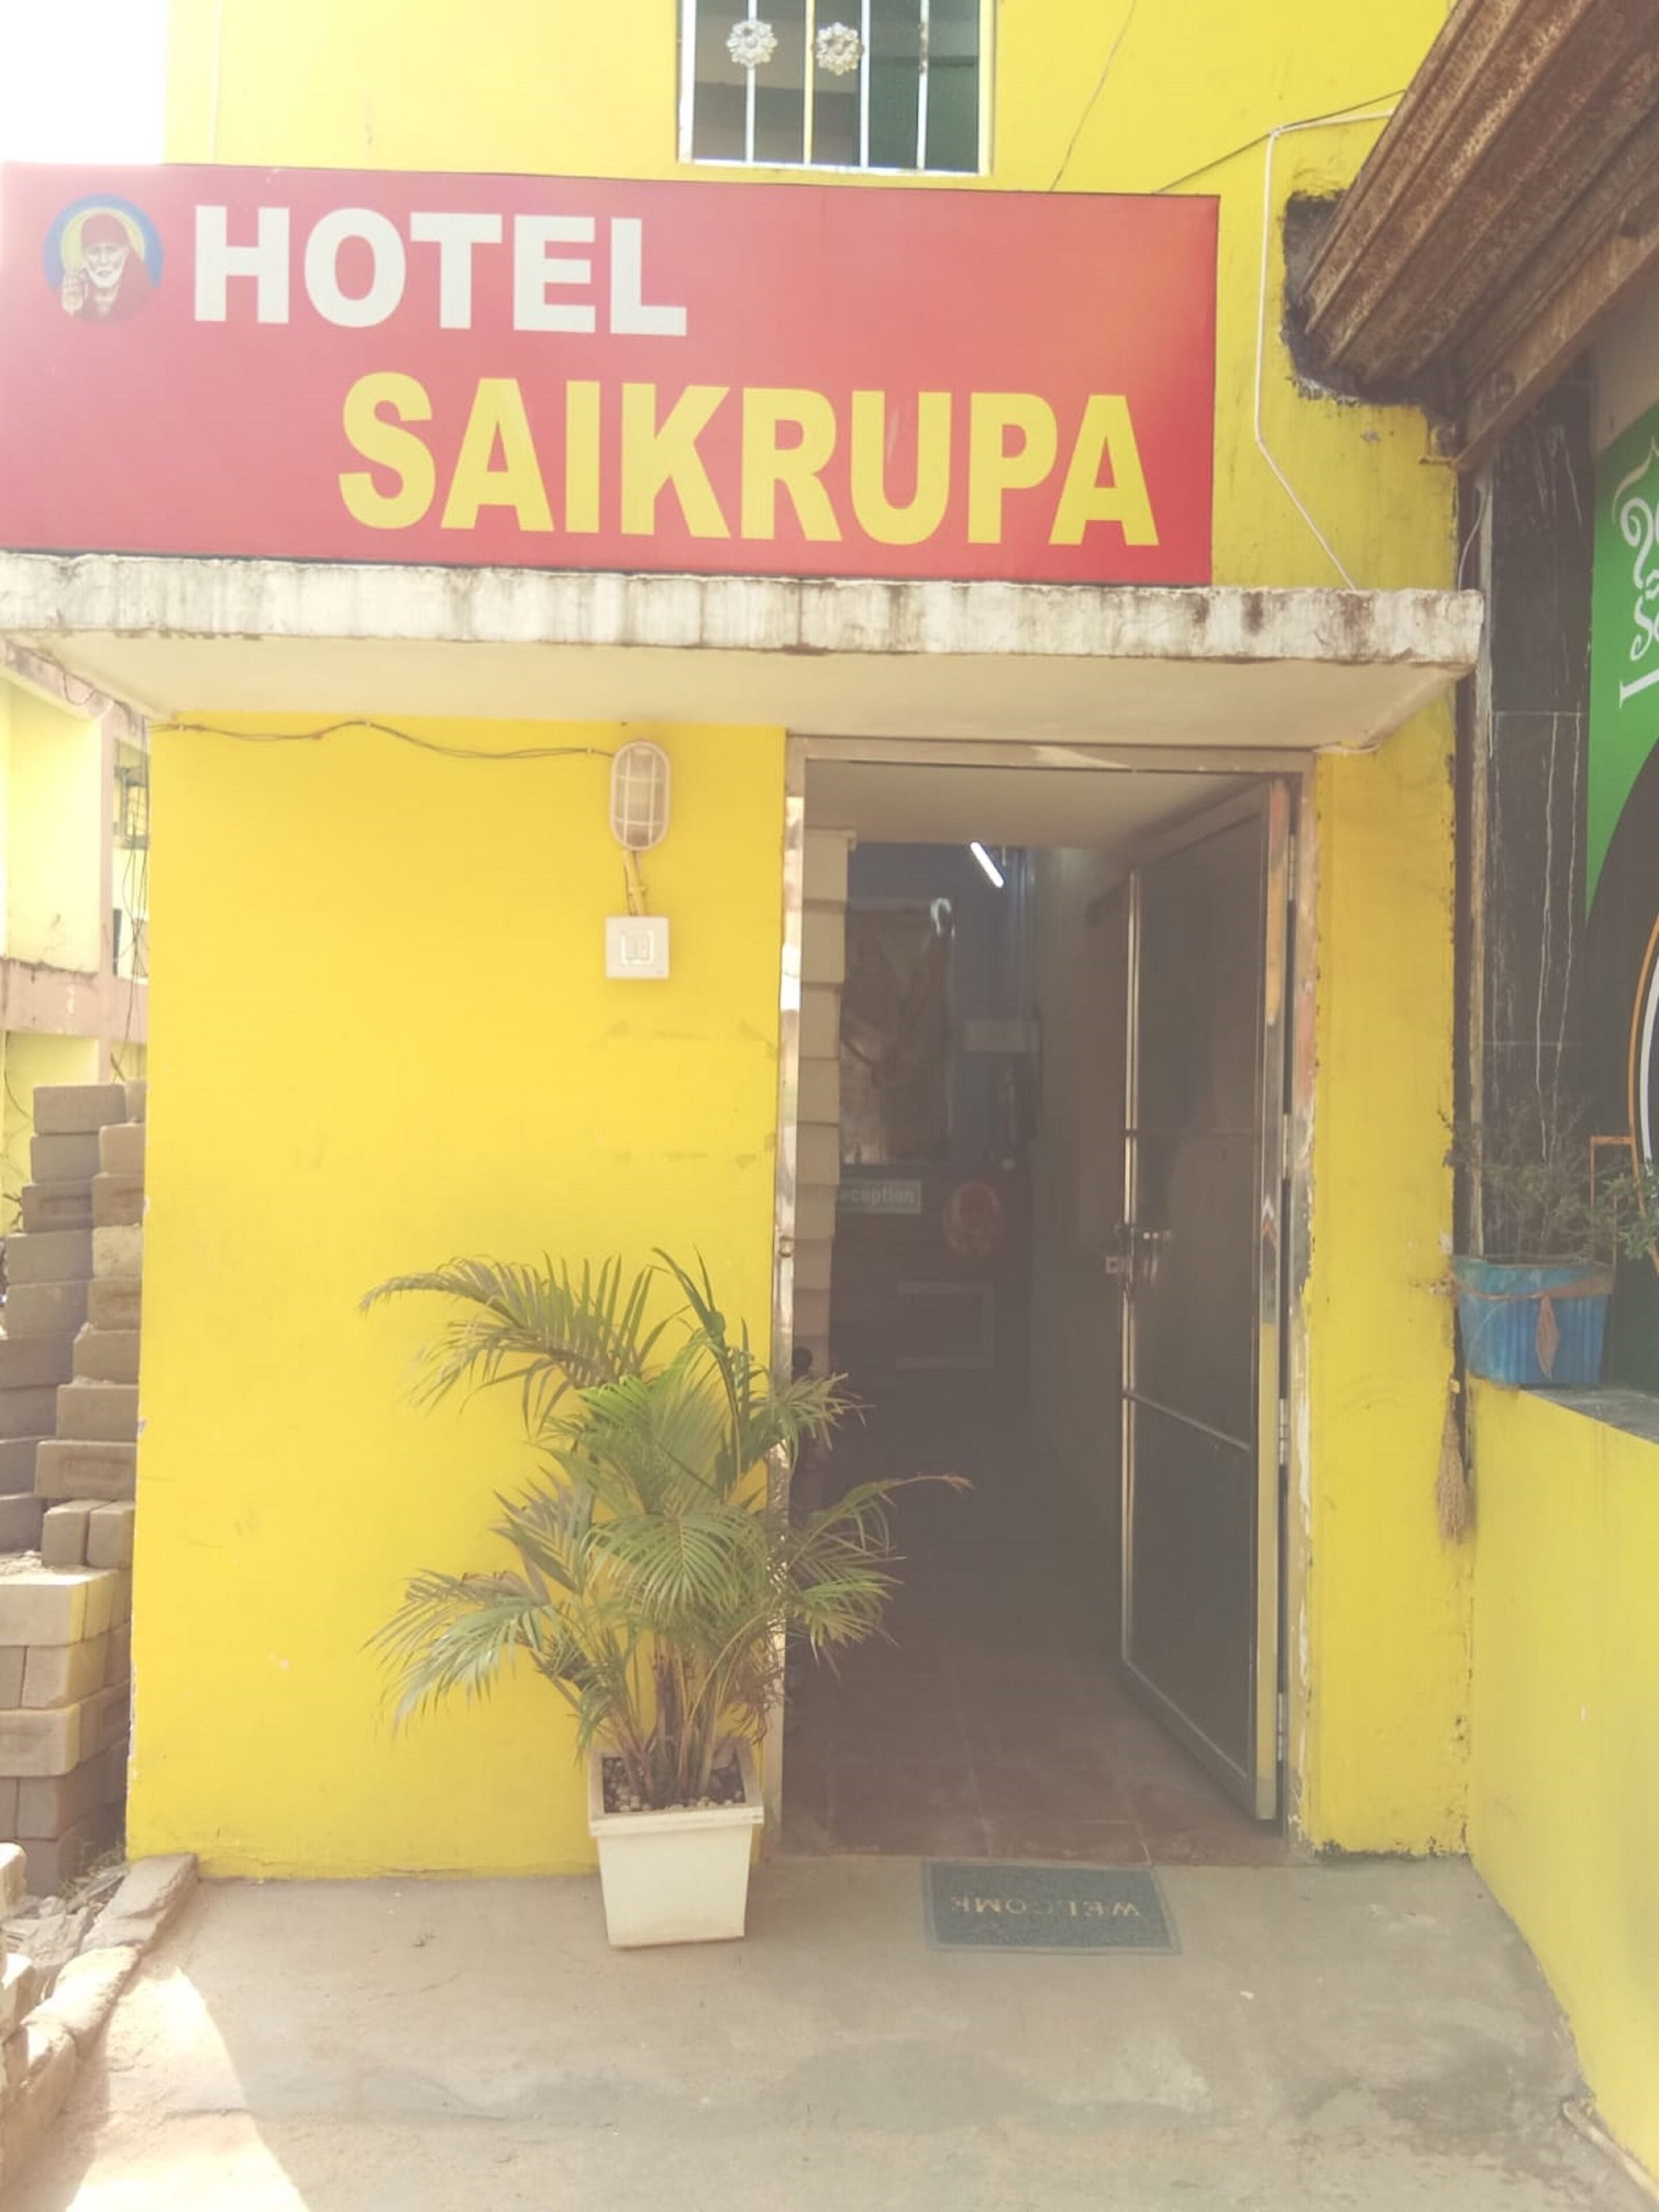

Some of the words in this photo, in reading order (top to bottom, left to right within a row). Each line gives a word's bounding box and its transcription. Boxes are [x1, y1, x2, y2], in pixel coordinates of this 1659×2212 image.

[195, 205, 687, 336] HOTEL
[339, 372, 1159, 547] SAIKRUPA
[839, 1183, 915, 1206] eception
[950, 1895, 1141, 1916] WELCOME
